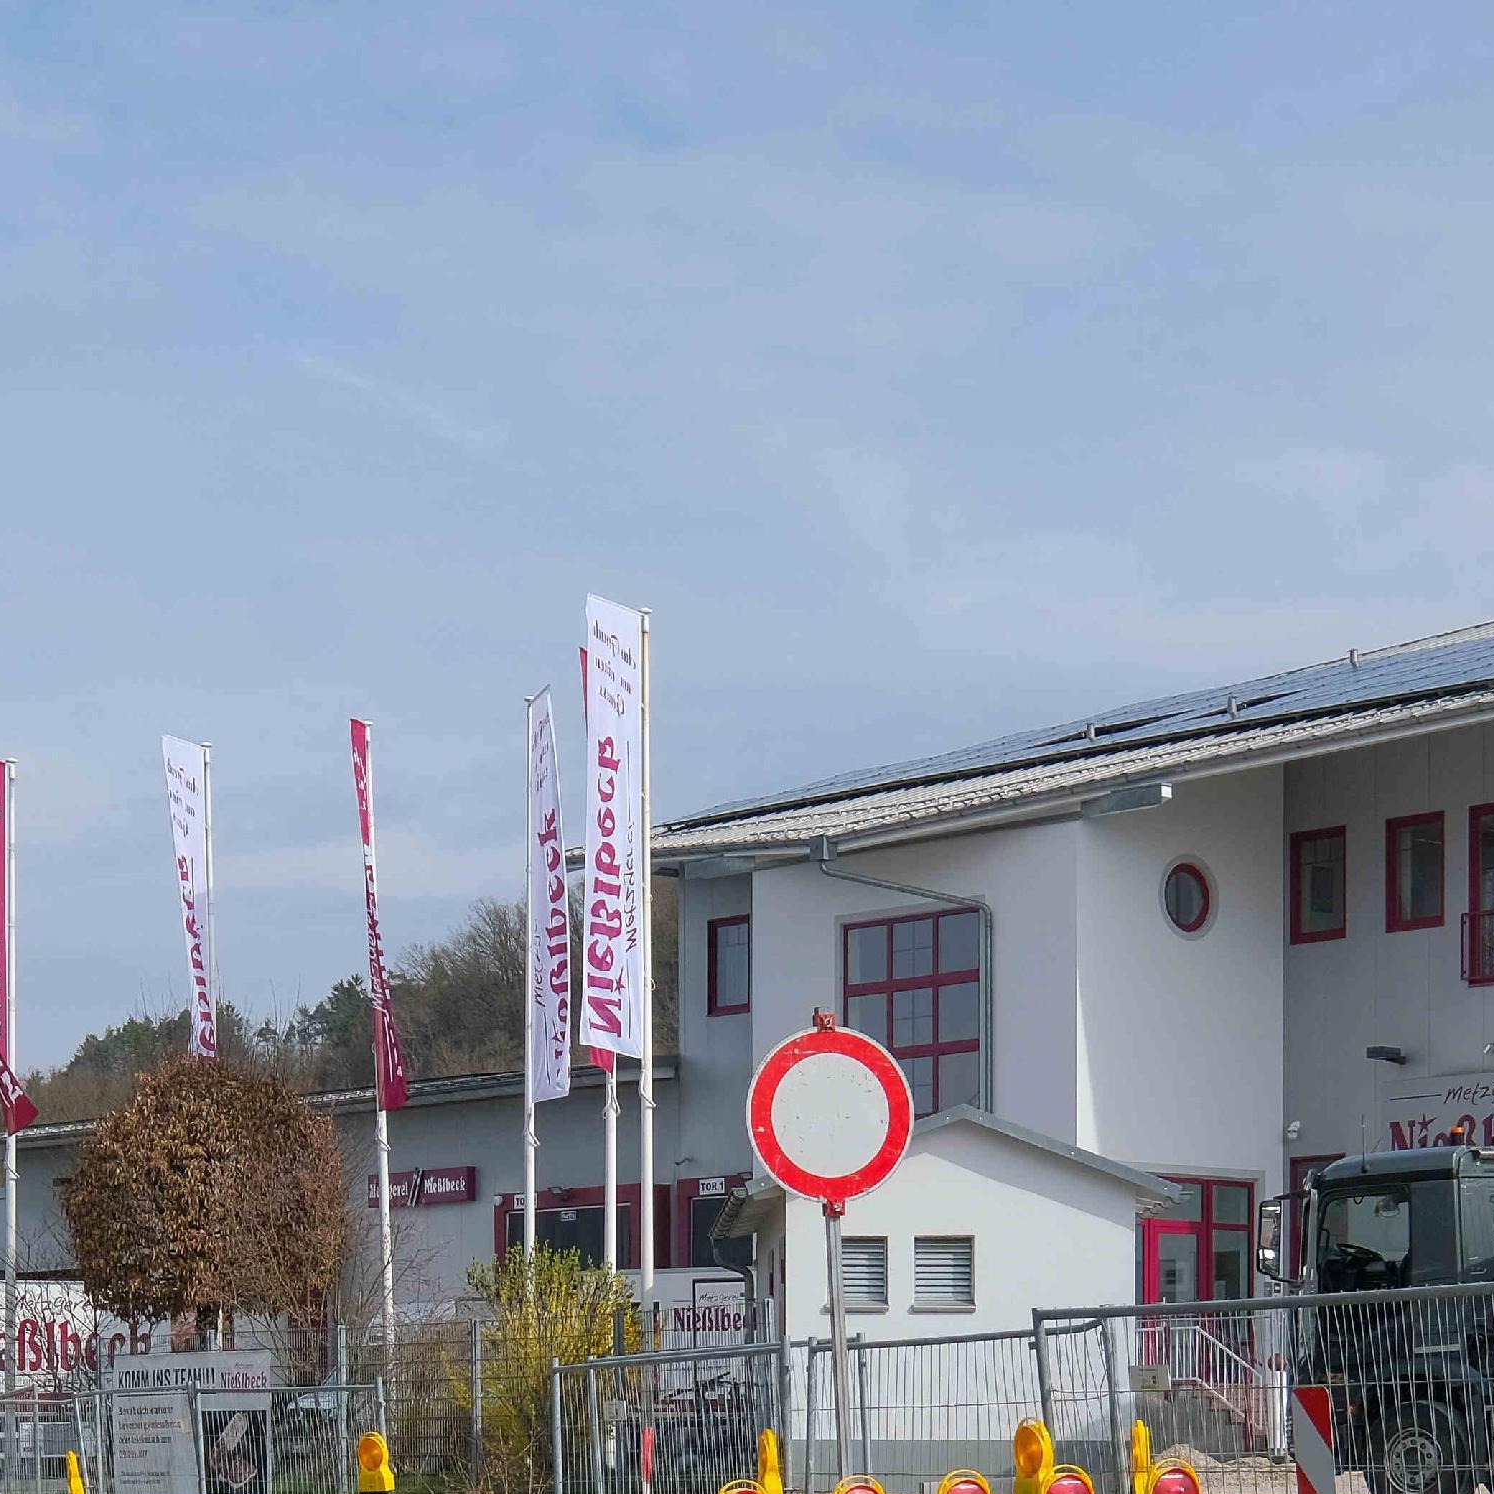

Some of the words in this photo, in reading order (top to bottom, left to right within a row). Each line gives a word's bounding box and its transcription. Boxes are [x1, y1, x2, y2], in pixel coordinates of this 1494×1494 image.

[424, 1176, 466, 1195] Nießlbeck
[701, 1182, 717, 1191] TOR
[720, 1181, 725, 1191] 1
[118, 1369, 148, 1388] KOMM
[153, 1368, 171, 1388] INS
